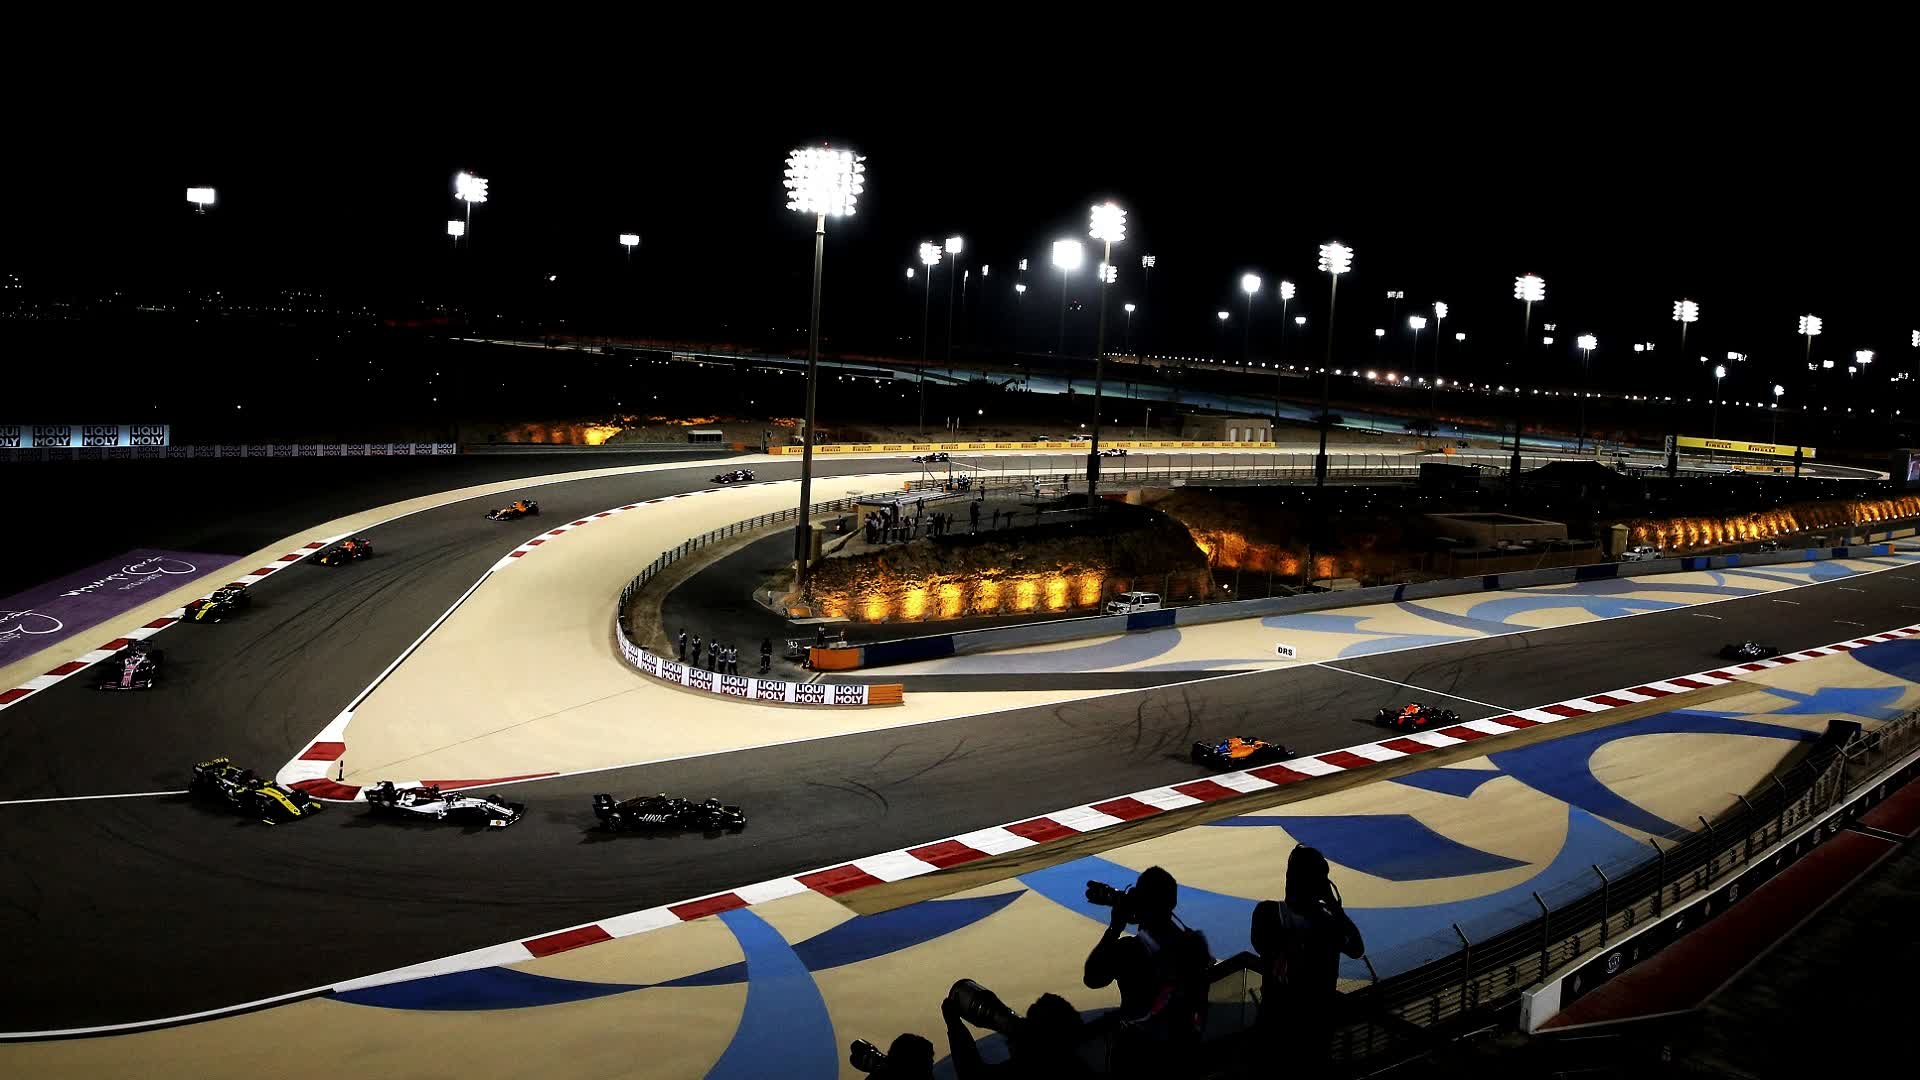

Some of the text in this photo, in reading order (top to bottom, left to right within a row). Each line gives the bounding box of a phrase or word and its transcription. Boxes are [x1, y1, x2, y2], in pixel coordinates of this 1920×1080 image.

[34, 426, 69, 436] LIQUI
[84, 426, 117, 436] LIQUI
[131, 426, 163, 436] LIQUI
[34, 437, 70, 446] MOLY
[84, 436, 118, 446] MOLY
[131, 436, 164, 446] MOLY
[1705, 440, 1732, 449] PIRELLI
[1748, 444, 1776, 453] PIRELLI
[1277, 646, 1293, 656] DRS
[642, 652, 656, 665] LIQUI
[642, 662, 656, 674] MOLY
[663, 661, 682, 674] LIQUI
[662, 671, 682, 683] MOLY
[690, 669, 712, 681] LIQUI
[690, 678, 712, 690] MOLY
[722, 675, 747, 687] LIQUI
[758, 681, 785, 691] LIQUI
[722, 685, 747, 696] MOLY
[797, 683, 824, 694] LIQUI
[836, 685, 862, 695] LIQUI
[758, 690, 785, 701] MOLY
[796, 693, 824, 703] MOLY
[835, 695, 863, 704] MOLY
